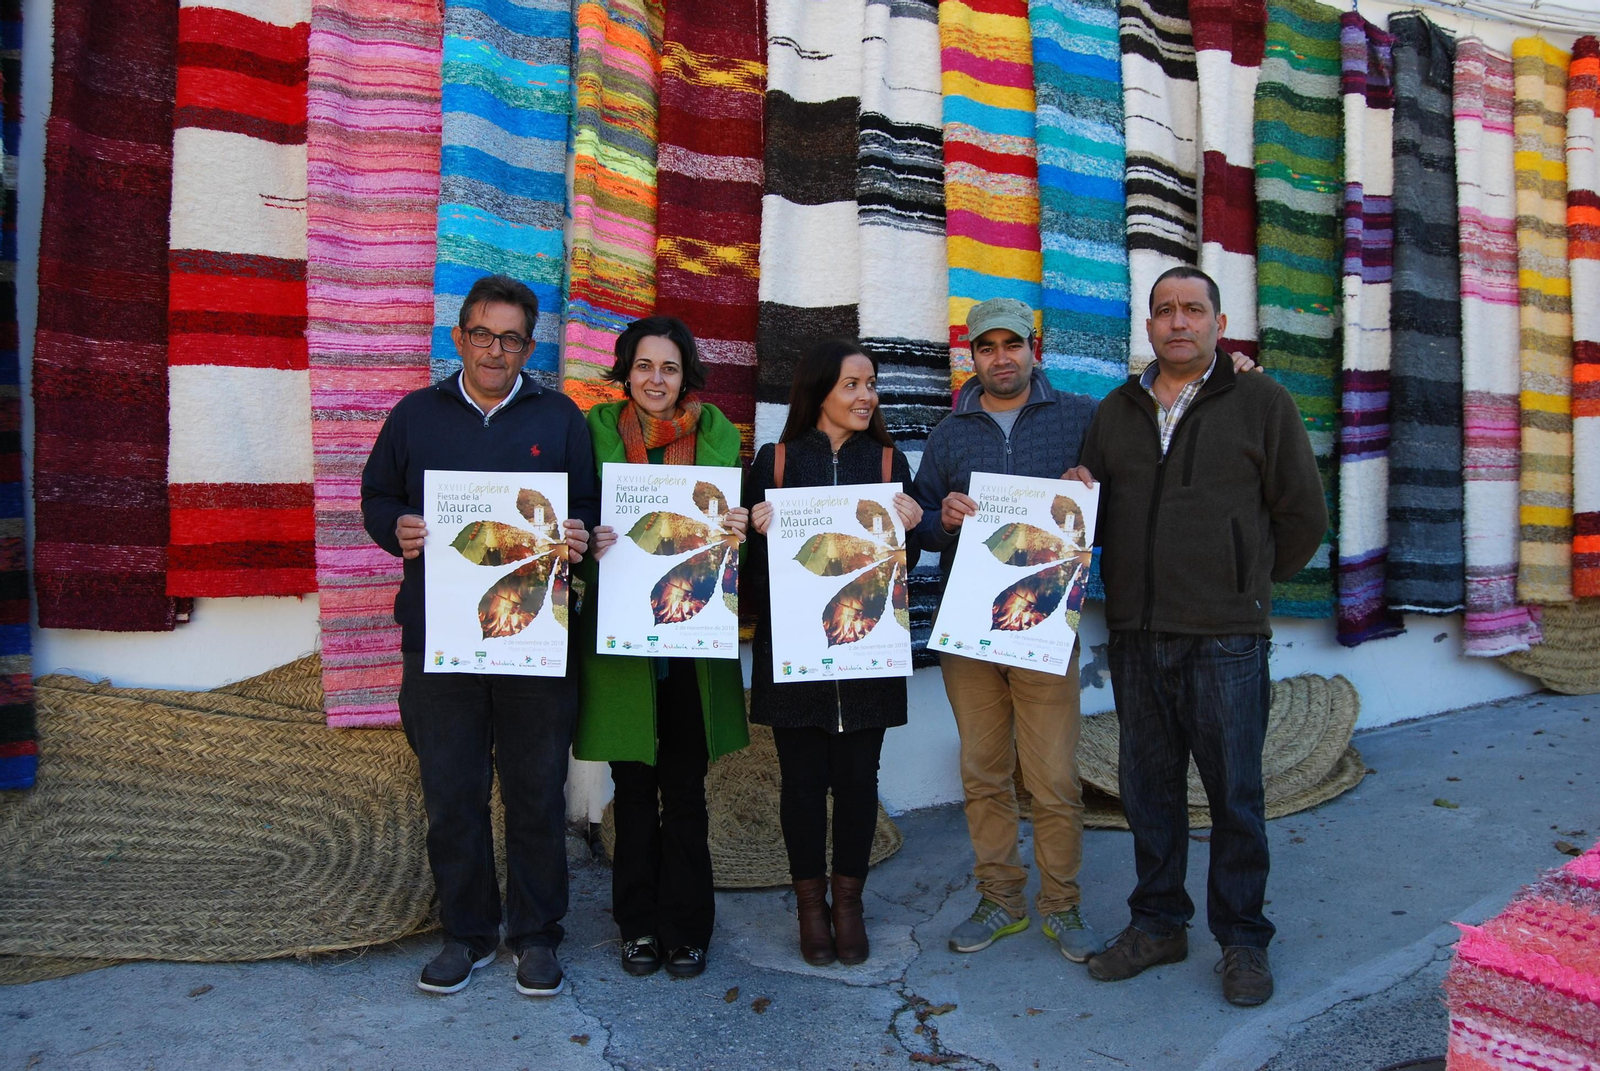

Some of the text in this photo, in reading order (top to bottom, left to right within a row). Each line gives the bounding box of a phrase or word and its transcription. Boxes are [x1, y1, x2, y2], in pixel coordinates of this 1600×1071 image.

[648, 474, 686, 488] Capileira
[468, 482, 510, 496] Capileira
[1008, 486, 1046, 499] Capileira
[616, 492, 668, 503] Mauraca
[810, 496, 849, 509] Capileira
[437, 501, 492, 513] Mauraca
[616, 505, 640, 514] 2018
[978, 501, 1028, 515] Mauraca
[437, 515, 463, 524] 2018
[781, 516, 832, 527] Mauraca
[978, 514, 1000, 524] 2018
[781, 529, 805, 538] 2018
